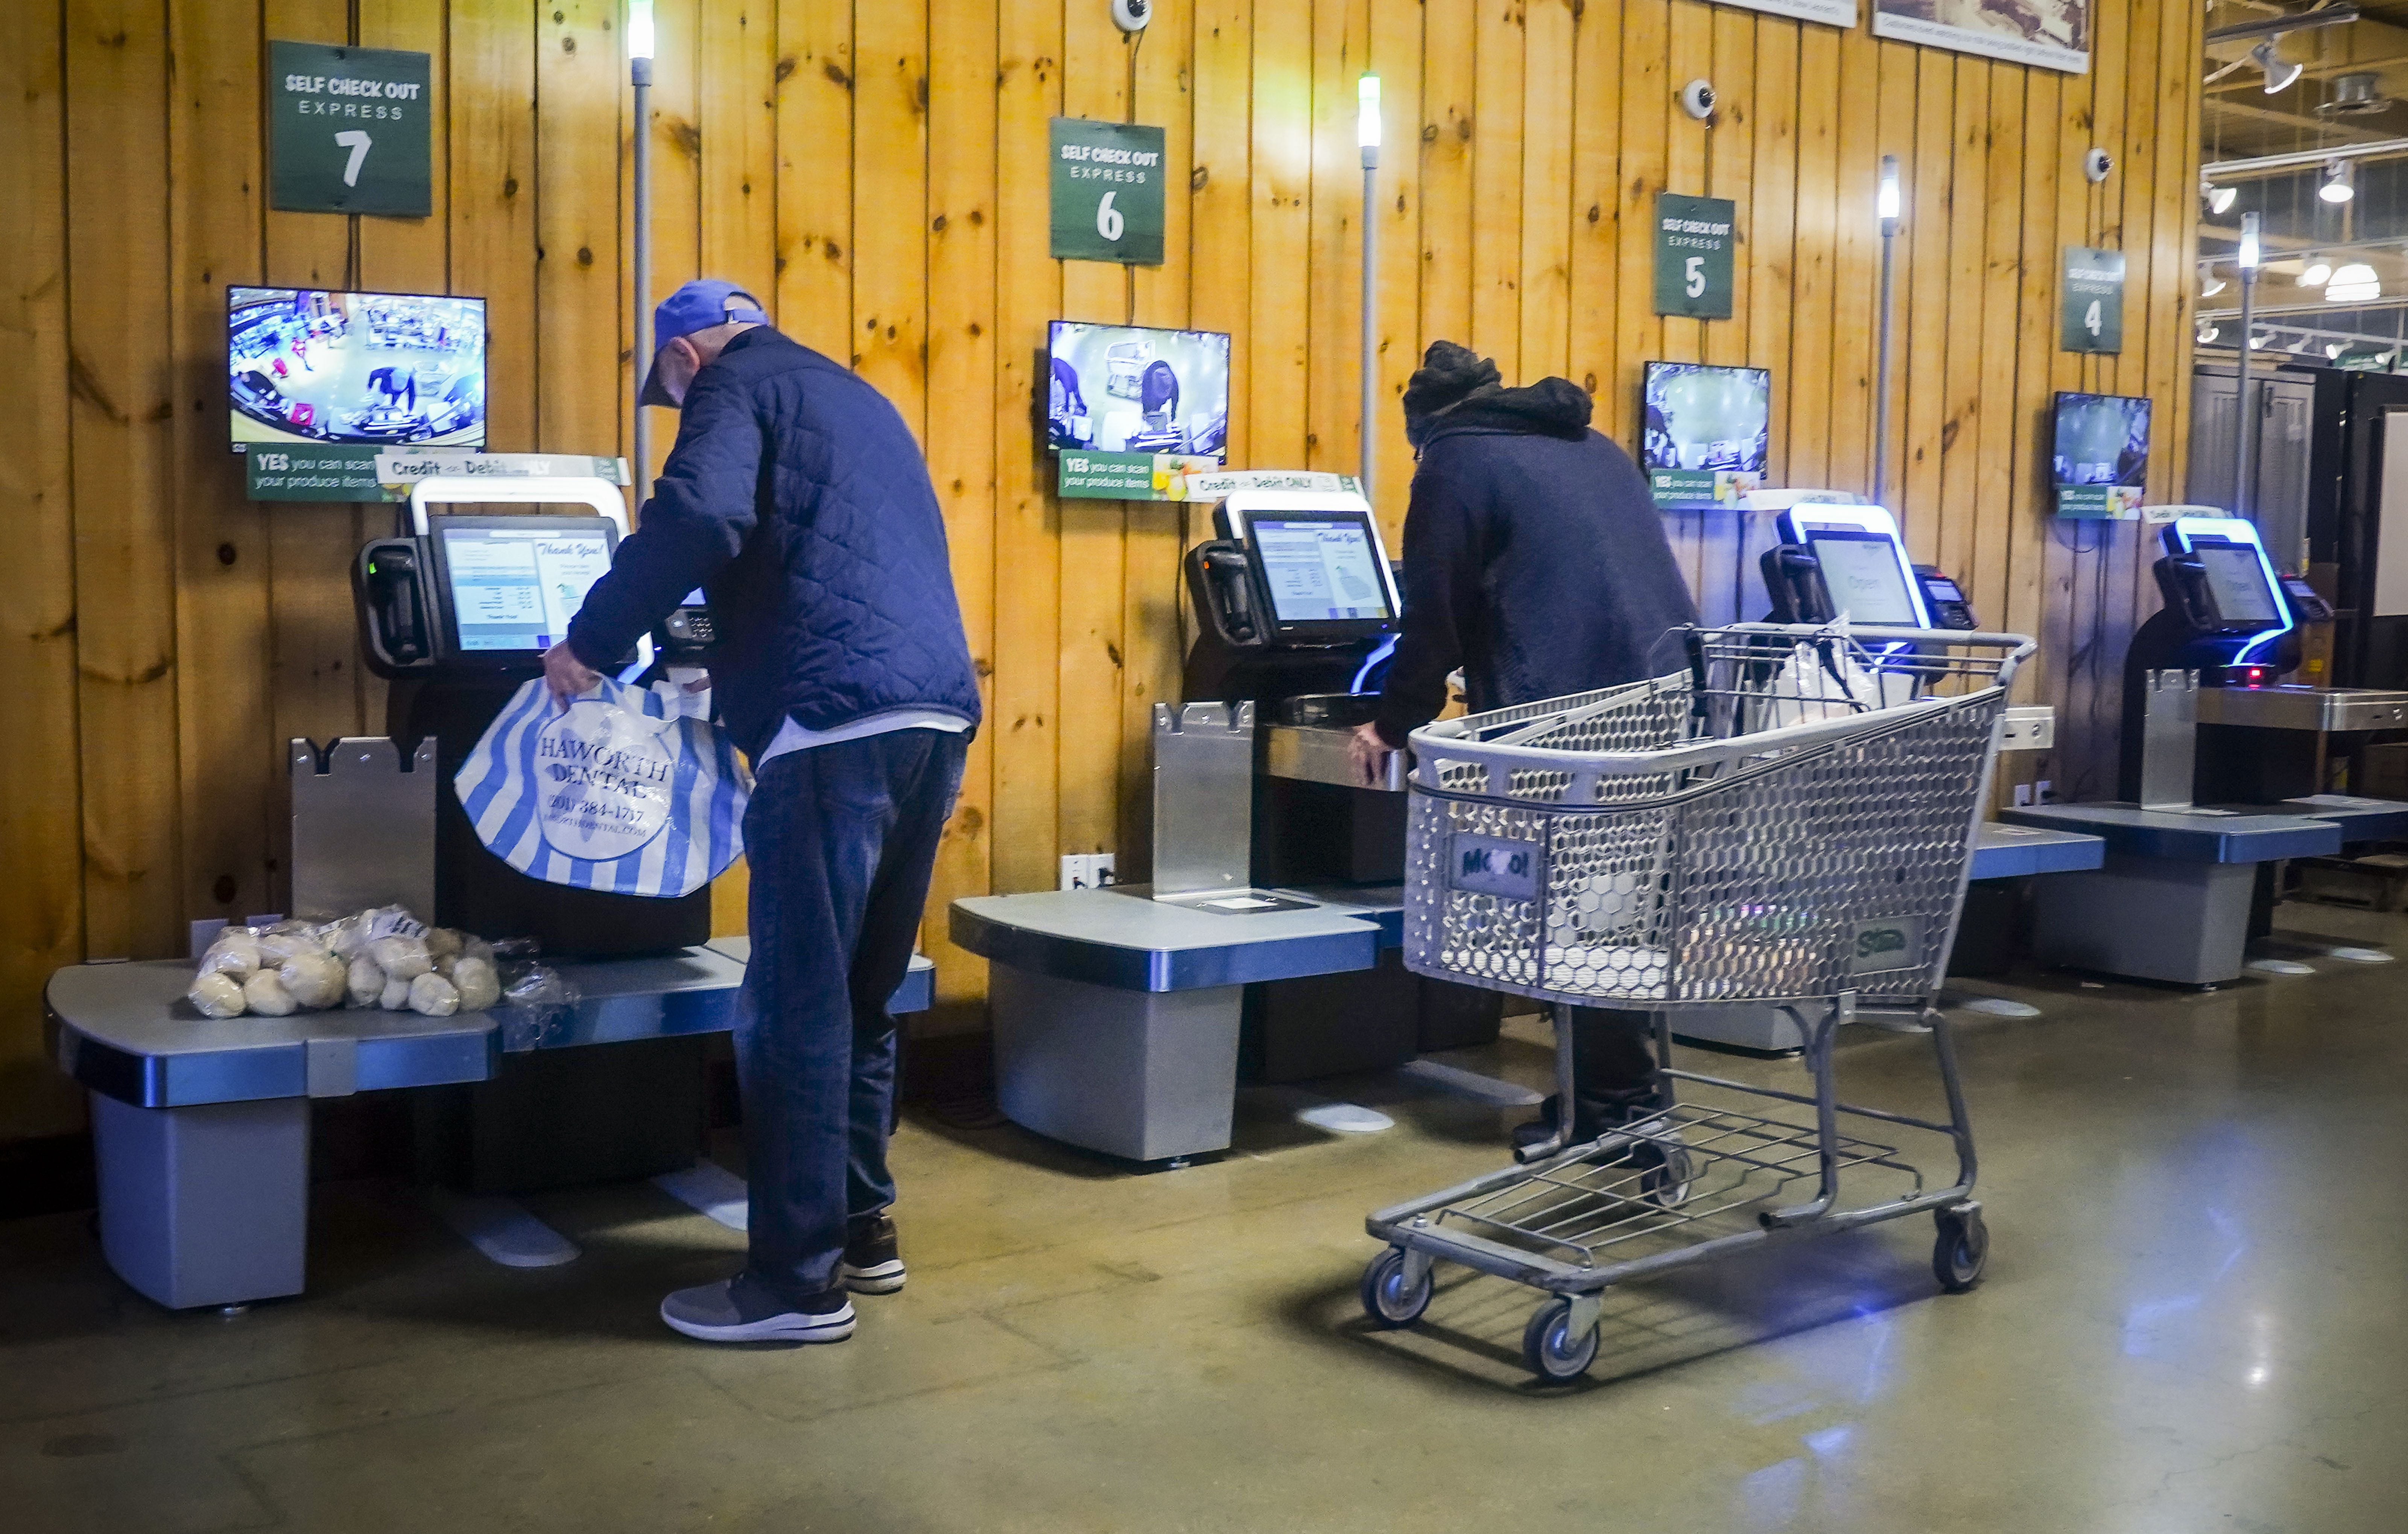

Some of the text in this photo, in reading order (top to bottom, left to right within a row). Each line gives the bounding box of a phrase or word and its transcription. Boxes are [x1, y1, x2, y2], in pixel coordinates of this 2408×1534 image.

[285, 74, 420, 100] SELF CHECK OUT
[299, 100, 402, 120] EXPRESS
[334, 130, 372, 187] 7
[1061, 145, 1159, 167] SELF CHECK OUT
[1070, 166, 1146, 184] EXPRESS
[1096, 190, 1124, 242] 6
[1668, 236, 1721, 250] EXPRESS
[1685, 256, 1706, 298] 5
[2084, 299, 2102, 336] 4
[256, 453, 289, 471] YES
[291, 459, 316, 472] you
[318, 460, 342, 470] can
[392, 460, 442, 476] Credit
[1066, 457, 1089, 473] YES
[1090, 463, 1108, 474] you
[255, 476, 285, 489] your
[287, 475, 340, 489] produce
[1064, 476, 1086, 488] your
[1086, 476, 1124, 489] produce
[538, 543, 574, 555] Thank
[540, 738, 668, 783] HAWORTH
[553, 762, 648, 799] DENTAL
